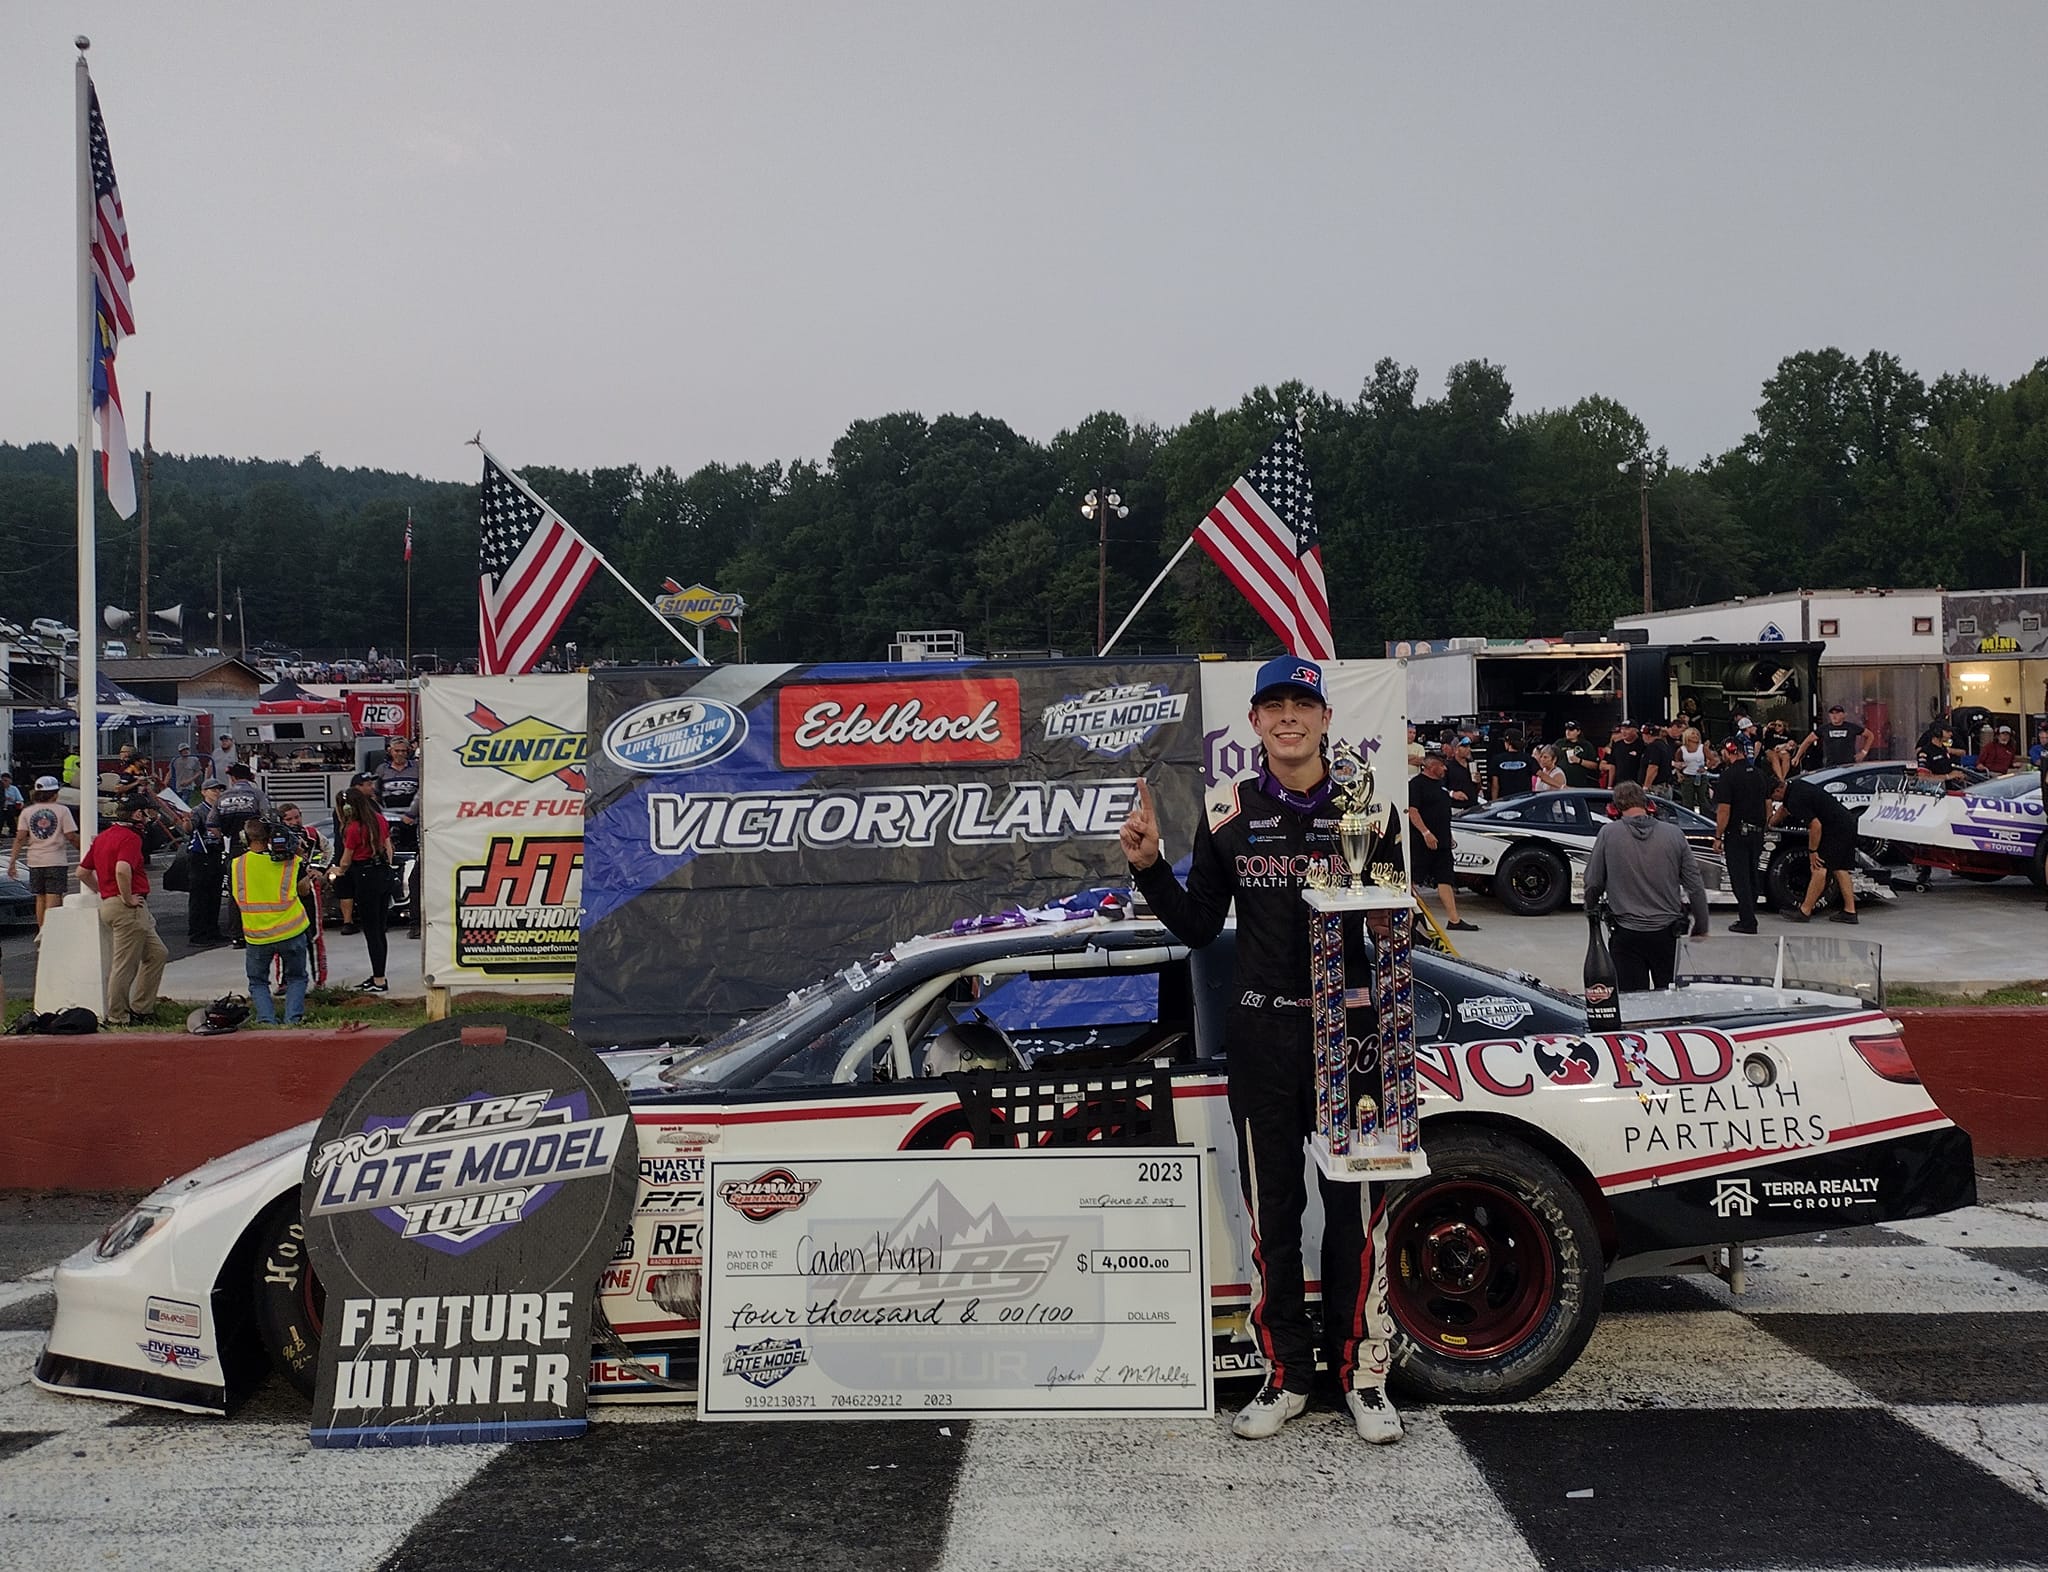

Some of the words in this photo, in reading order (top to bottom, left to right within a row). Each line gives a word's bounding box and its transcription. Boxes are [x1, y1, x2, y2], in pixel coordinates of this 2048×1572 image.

[662, 600, 734, 612] SUNOCO
[1086, 683, 1152, 704] CARS
[623, 705, 694, 740] CARS
[796, 699, 1000, 748] Edelbrock
[1041, 701, 1076, 723] PRO
[1051, 709, 1107, 736] LATE
[1110, 700, 1180, 727] MODEL
[625, 741, 653, 755] LATE
[654, 731, 690, 747] MODEL
[692, 717, 726, 736] STOCK
[1088, 727, 1144, 750] TOUR
[659, 735, 704, 761] TOUR
[456, 800, 530, 817] RACE
[651, 790, 951, 852] VICTORY
[959, 785, 1142, 841] LANE
[1871, 801, 1927, 822] yahoo!
[1991, 843, 2023, 853] TOYOTA
[461, 908, 519, 928] HANK
[1464, 1005, 1498, 1018] LATE
[1636, 1081, 1801, 1116] WEALTH
[402, 1091, 553, 1143] CARS
[1625, 1114, 1825, 1154] PARTNERS
[312, 1127, 390, 1177] PRO
[320, 1149, 453, 1206] LATE
[454, 1126, 609, 1188] MODEL
[1138, 1162, 1184, 1182] 2023
[1762, 1179, 1817, 1196] TERRA
[1820, 1178, 1880, 1194] REALTY
[402, 1188, 527, 1238] TOUR
[1793, 1197, 1853, 1208] GROUP
[727, 1251, 743, 1260] PAY
[745, 1251, 758, 1259] TO
[760, 1250, 778, 1259] THE
[727, 1262, 759, 1271] ORDER
[761, 1261, 774, 1270] OF
[796, 1235, 866, 1276] Caden
[1077, 1253, 1088, 1273] $
[1102, 1256, 1169, 1271] 4,000.00
[340, 1292, 573, 1350] FEATURE
[732, 1302, 800, 1332] four
[804, 1298, 945, 1326] thousand
[998, 1303, 1074, 1324] 00/100
[1127, 1311, 1170, 1321] DOLLARS
[148, 1341, 171, 1353] FIVE
[174, 1345, 200, 1359] STAR
[726, 1357, 762, 1373] LATE
[763, 1350, 807, 1368] MODEL
[333, 1354, 570, 1409] WINNER
[744, 1395, 817, 1408] 9192130371
[830, 1394, 902, 1407] 7046229212
[923, 1394, 953, 1406] 2023
